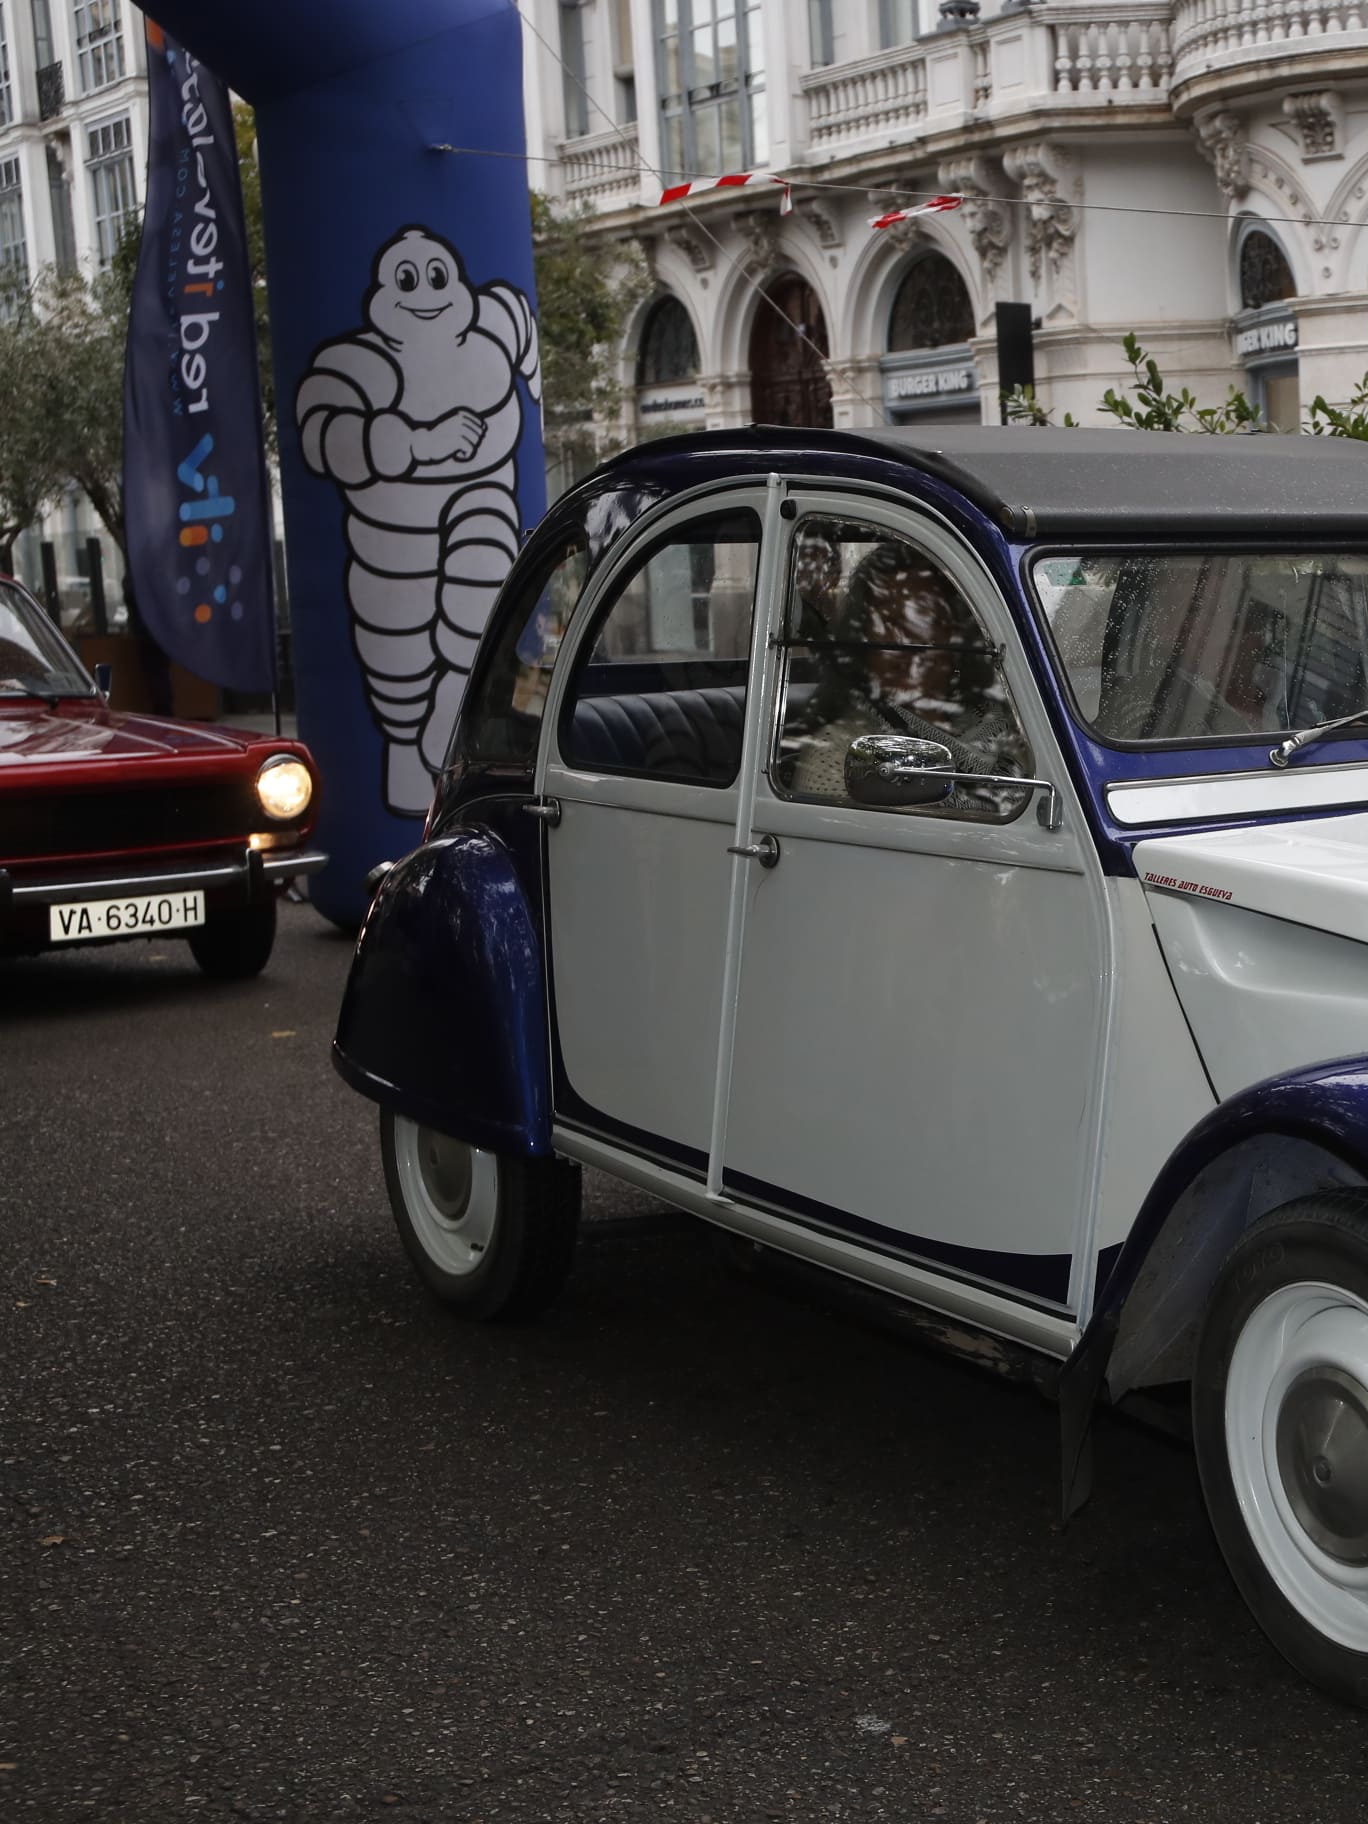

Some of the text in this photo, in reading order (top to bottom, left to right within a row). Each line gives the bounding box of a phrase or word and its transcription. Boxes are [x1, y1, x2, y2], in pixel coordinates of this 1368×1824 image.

[1260, 322, 1297, 349] KING
[889, 369, 969, 399] BURGER KING
[1144, 872, 1233, 901] TALLERES AUTO ESGUEVA
